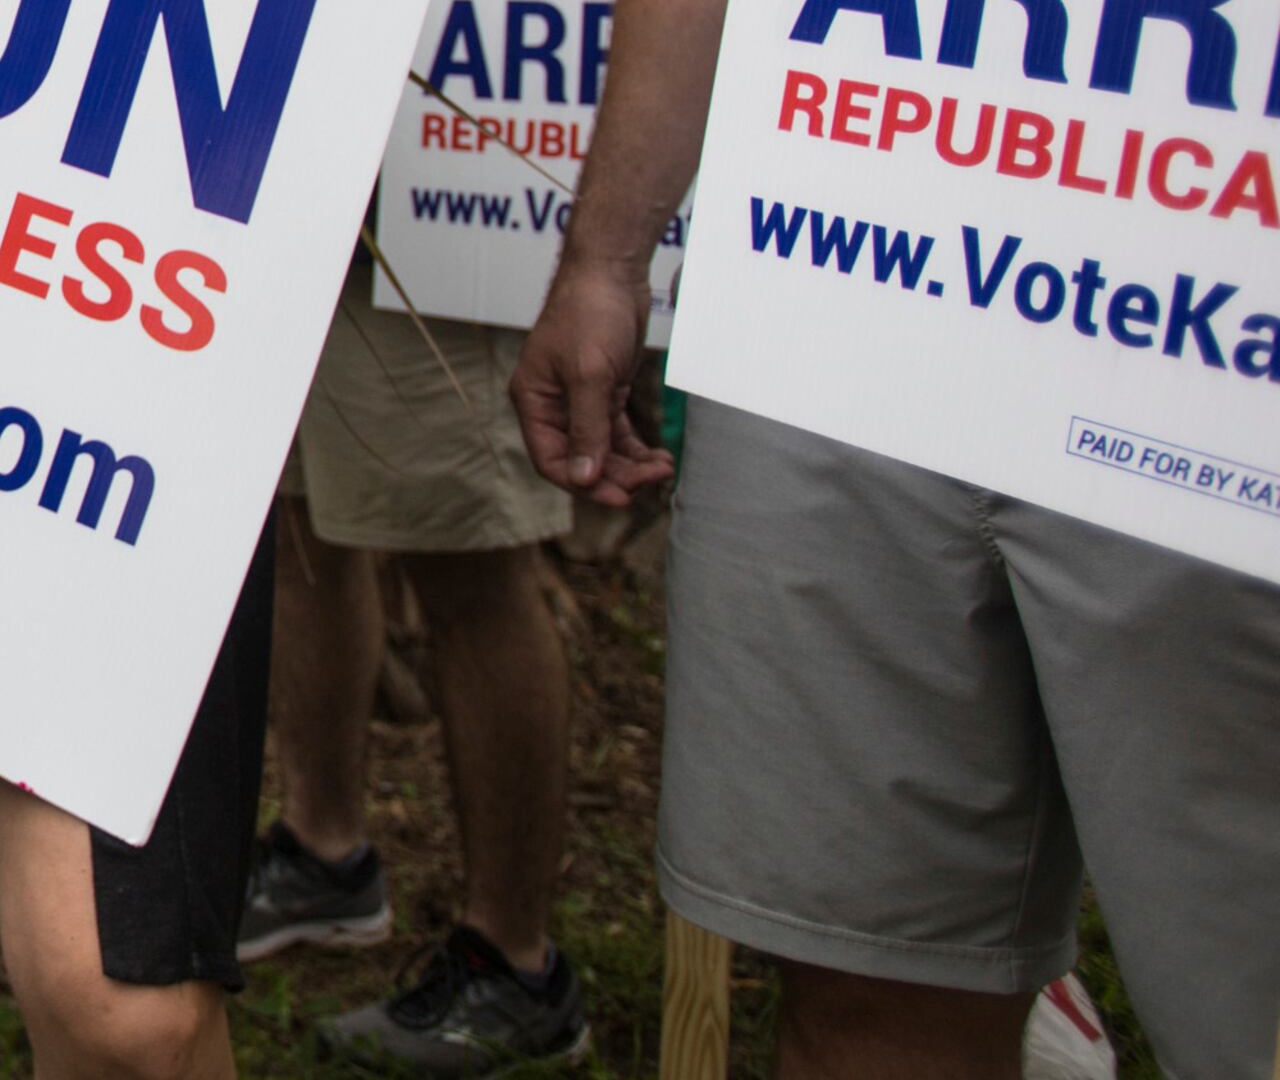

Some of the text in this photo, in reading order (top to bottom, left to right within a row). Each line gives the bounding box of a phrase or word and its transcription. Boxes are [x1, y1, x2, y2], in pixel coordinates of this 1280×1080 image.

[1076, 429, 1134, 467] PAID
[1139, 447, 1191, 481] FOR
[1195, 465, 1235, 491] BY
